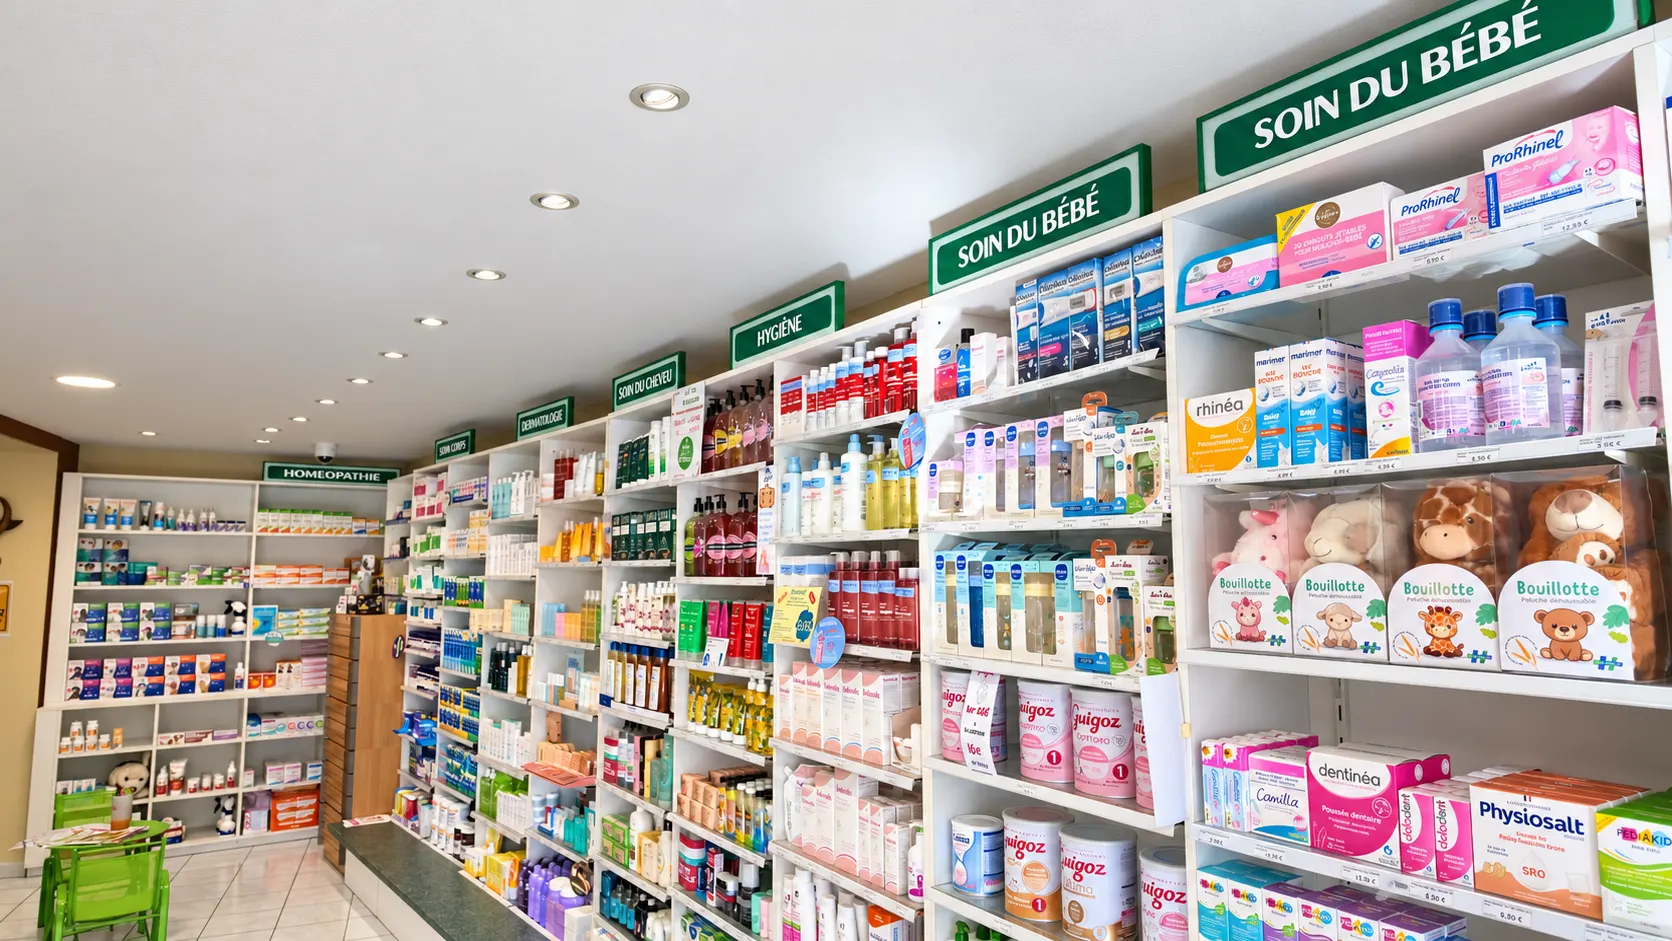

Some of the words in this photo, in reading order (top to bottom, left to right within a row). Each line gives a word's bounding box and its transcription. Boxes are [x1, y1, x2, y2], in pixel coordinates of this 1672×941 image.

[1254, 89, 1340, 150] SOIN
[1350, 61, 1410, 111] DU
[1421, 0, 1542, 80] BÉBÉ
[1491, 130, 1563, 167] ProRhinel
[1401, 187, 1460, 217] ProRhinel
[958, 231, 1002, 268] SOIN
[1007, 217, 1037, 249] DU
[1042, 184, 1100, 236] BÉBÉ
[757, 314, 802, 348] HYGIÈNE
[1256, 356, 1286, 367] marimer
[1291, 349, 1323, 361] marimer
[618, 385, 634, 400] SOIN
[635, 379, 645, 394] DU
[645, 368, 672, 390] CHEVEU
[1197, 397, 1243, 417] rhinéa
[284, 469, 380, 481] HOMEOPATHIE
[1220, 577, 1271, 590] Bouillotte
[1305, 579, 1365, 592] Bouillotte
[1403, 581, 1474, 597] Bouillotte
[1517, 580, 1600, 598] Bouillotte
[1050, 751, 1059, 764] 1
[1116, 765, 1124, 779] 1
[1319, 763, 1381, 788] dentinéa
[1479, 801, 1585, 836] Physiosalt
[1617, 827, 1672, 847] PEDIAKID
[1522, 866, 1546, 880] SRO
